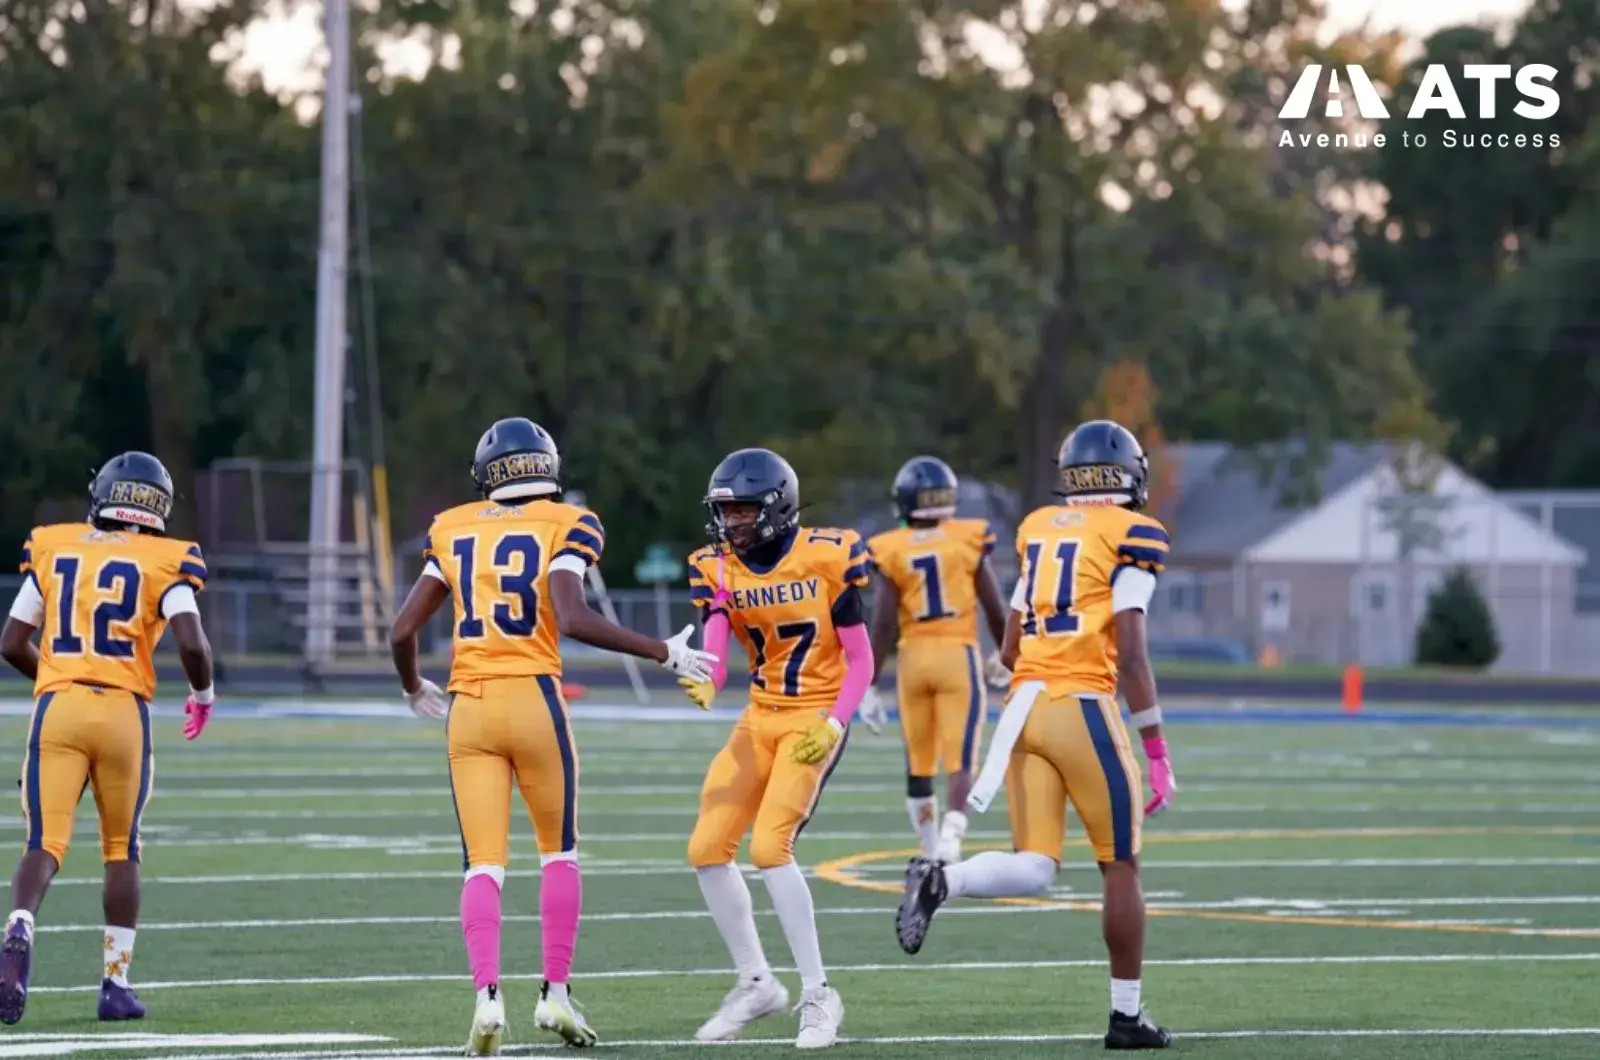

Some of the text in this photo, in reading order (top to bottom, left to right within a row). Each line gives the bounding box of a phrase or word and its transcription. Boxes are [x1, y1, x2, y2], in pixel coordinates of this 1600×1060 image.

[486, 452, 552, 487] EAGLES
[116, 509, 157, 524] Riddell
[52, 555, 141, 658] 12
[451, 532, 541, 639] 13
[910, 552, 958, 621] 1
[1021, 538, 1082, 638] 11
[744, 619, 818, 697] 17
